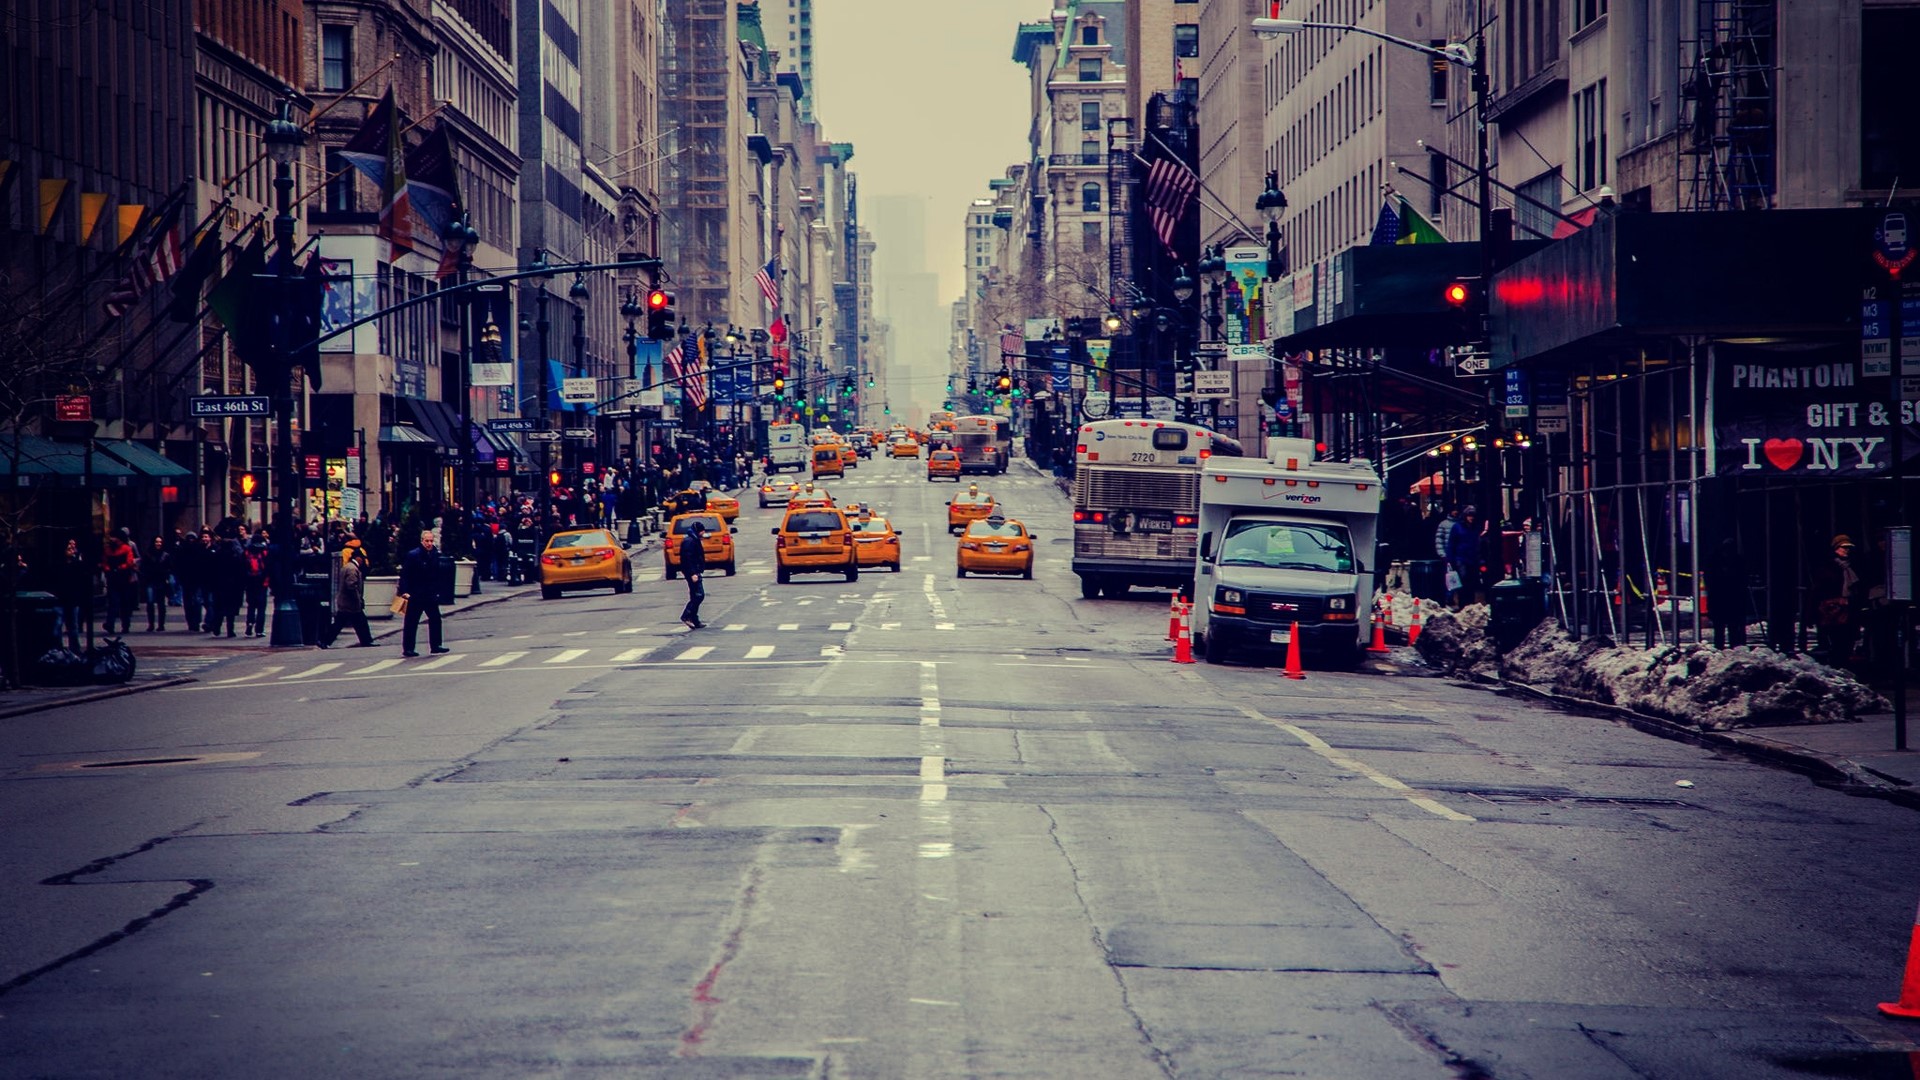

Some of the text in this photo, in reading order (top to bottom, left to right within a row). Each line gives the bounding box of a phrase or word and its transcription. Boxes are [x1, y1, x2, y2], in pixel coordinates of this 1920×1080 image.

[1863, 287, 1877, 300] M2
[1863, 303, 1878, 317] M3
[1863, 322, 1879, 336] M5
[1232, 347, 1265, 355] CBRE
[1864, 343, 1888, 354] NYMT
[1465, 358, 1485, 369] ONE
[1507, 371, 1518, 380] M1
[1732, 362, 1855, 389] PHANTOM
[1507, 383, 1518, 392] M4
[196, 400, 264, 412] East 46th St
[1807, 402, 1859, 428] GIFT
[1868, 401, 1891, 426] &
[492, 421, 533, 430] East 45th St
[1131, 452, 1156, 463] 2720
[1741, 437, 1763, 470] I
[1285, 493, 1321, 504] verizon
